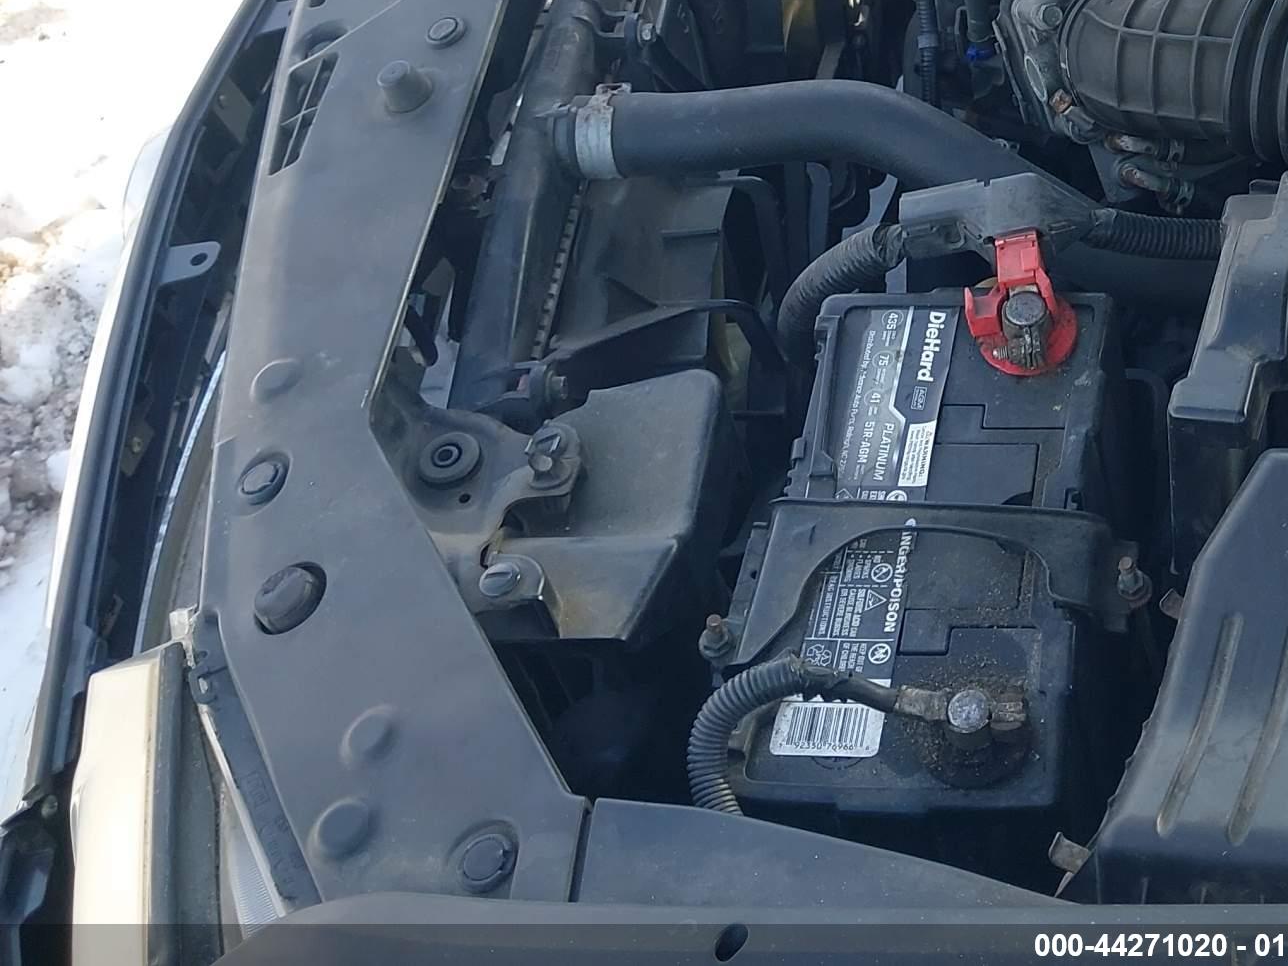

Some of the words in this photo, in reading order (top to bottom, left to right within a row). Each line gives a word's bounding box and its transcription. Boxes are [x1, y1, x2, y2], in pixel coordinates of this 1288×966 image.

[887, 312, 898, 330] 435
[879, 354, 889, 366] 75
[917, 311, 946, 381] DieHard
[870, 392, 881, 403] 41
[857, 421, 875, 464] 51R-AGM
[873, 423, 895, 481] PLATINUM
[884, 532, 912, 632] NGER/POISON
